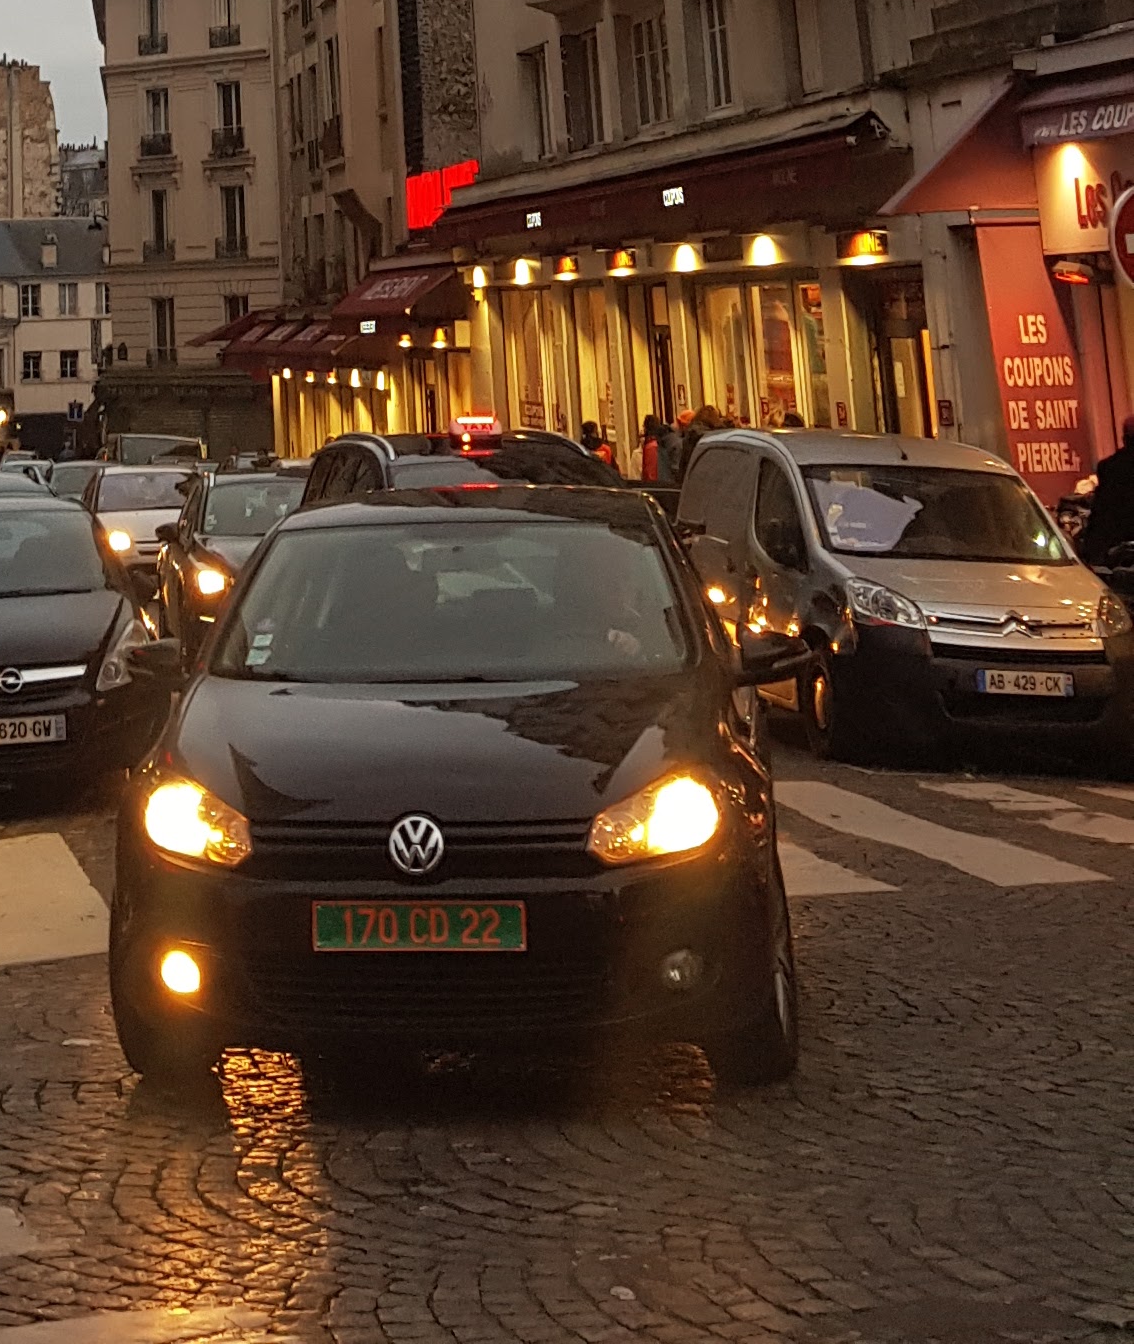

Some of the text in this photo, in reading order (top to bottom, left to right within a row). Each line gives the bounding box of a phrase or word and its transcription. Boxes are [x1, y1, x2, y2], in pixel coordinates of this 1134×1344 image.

[1059, 110, 1088, 136] LES
[1074, 177, 1108, 230] Les
[1018, 314, 1048, 344] LES
[1003, 355, 1075, 388] COUPONS
[1008, 399, 1079, 430] DE SAINT
[343, 908, 502, 945] 170 CD 22
